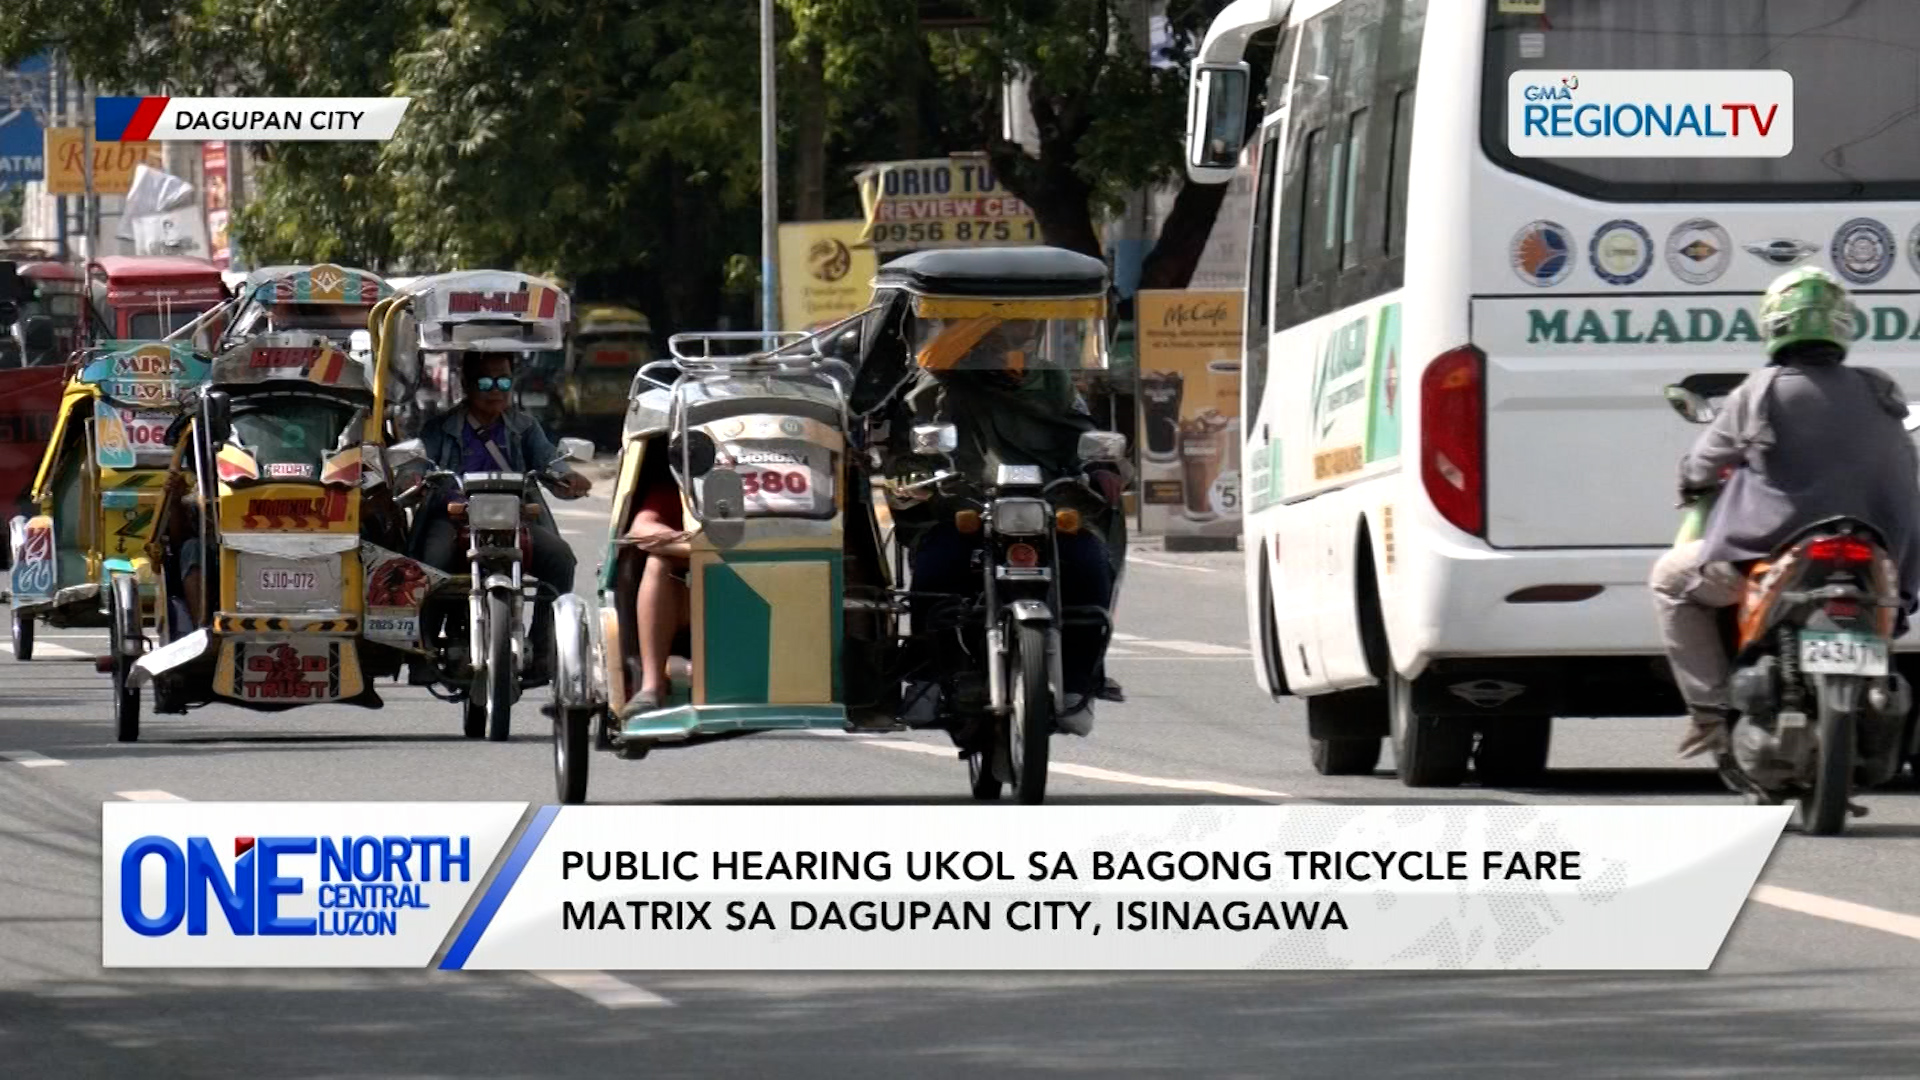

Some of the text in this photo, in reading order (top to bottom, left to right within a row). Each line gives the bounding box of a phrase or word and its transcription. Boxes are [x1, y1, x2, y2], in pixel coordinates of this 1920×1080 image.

[0, 156, 42, 172] ATM
[879, 200, 978, 223] REVIEW
[873, 221, 945, 243] 0956
[957, 221, 1011, 242] 875
[742, 471, 807, 495] 380
[244, 681, 329, 698] TRUST
